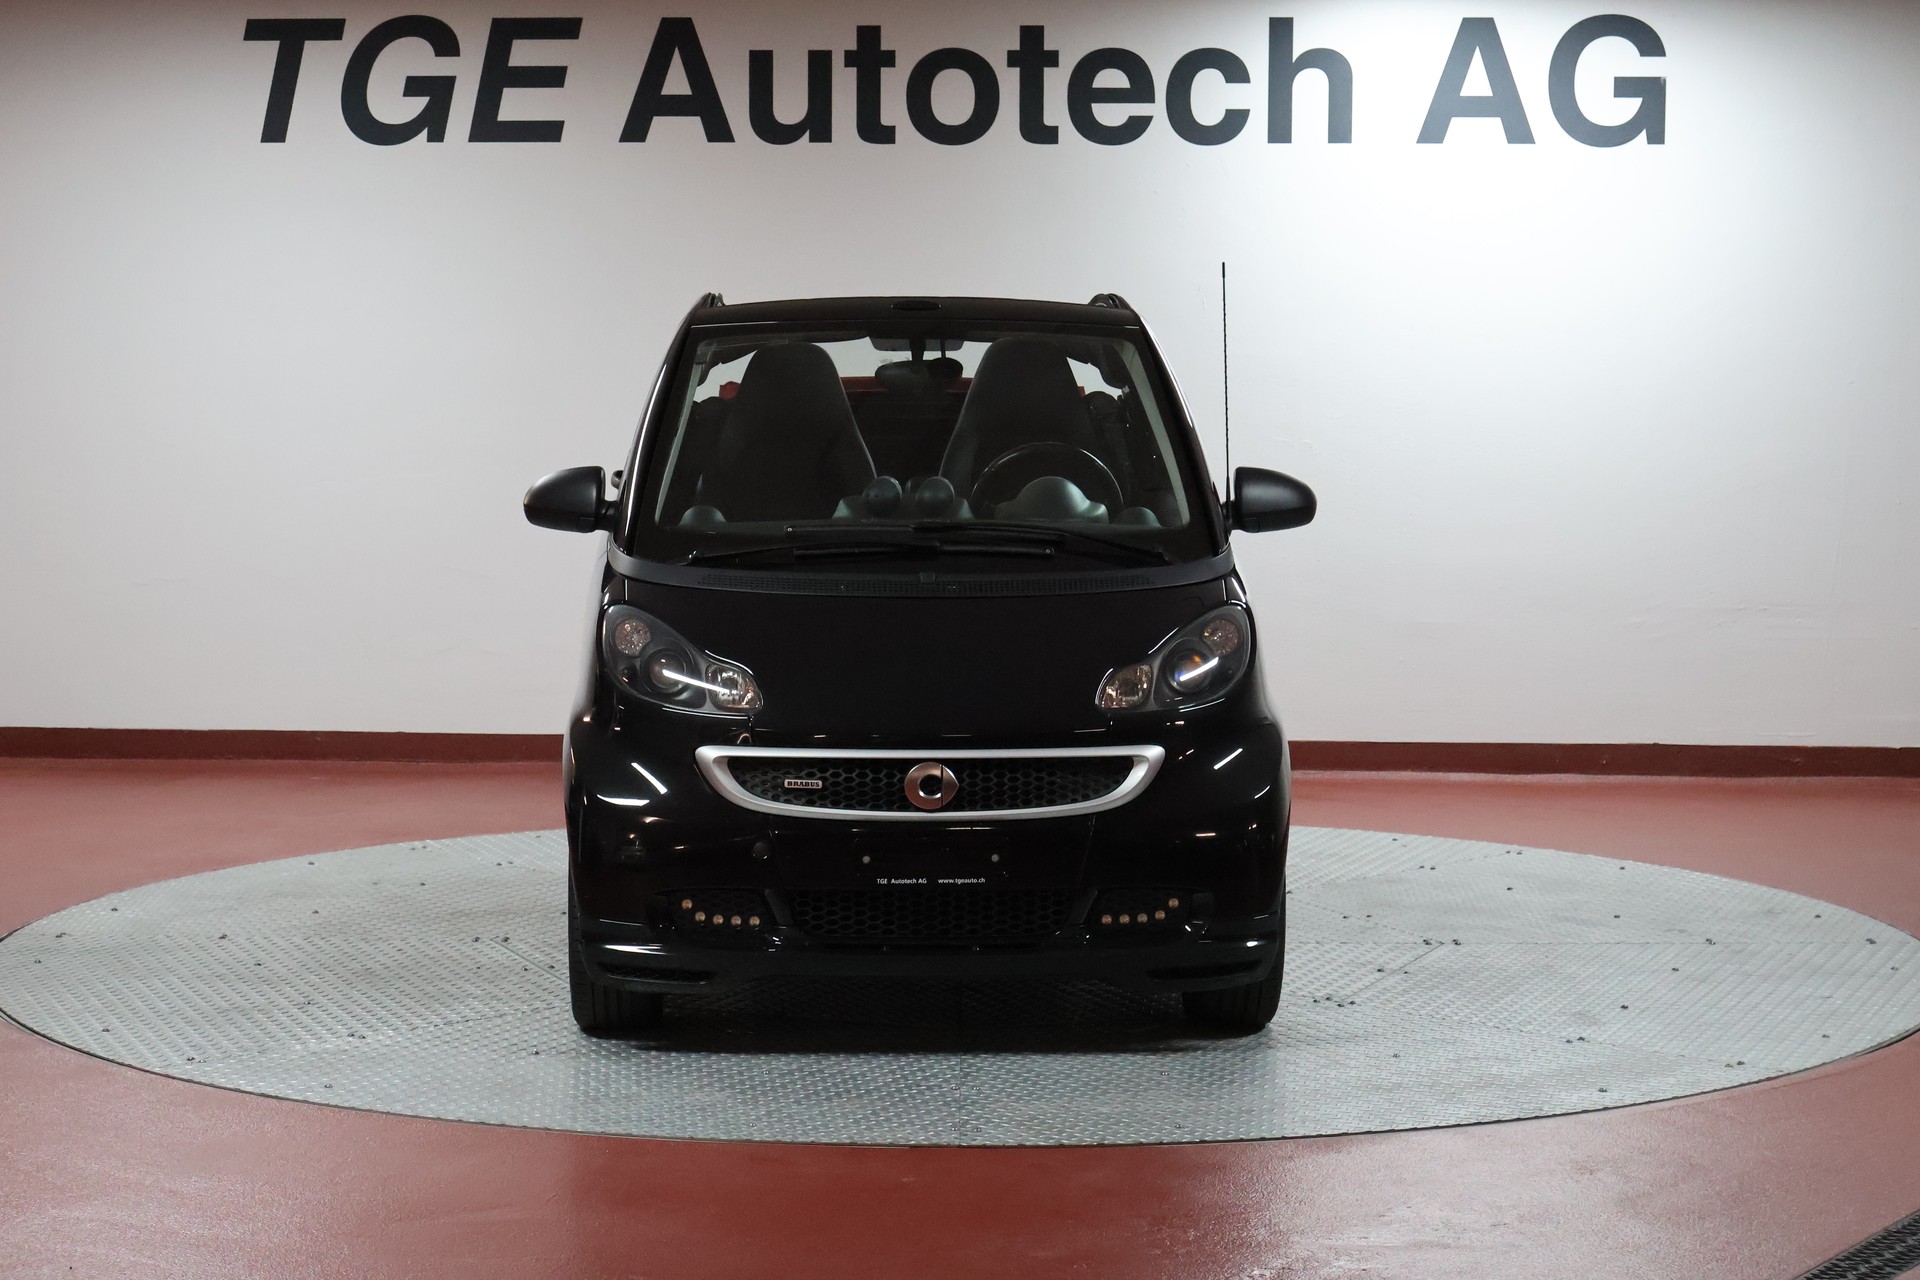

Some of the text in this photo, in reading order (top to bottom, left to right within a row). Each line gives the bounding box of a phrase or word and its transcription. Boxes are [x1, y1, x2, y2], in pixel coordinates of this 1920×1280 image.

[243, 14, 1667, 147] TGE Autotech AG
[938, 877, 986, 885] www.tgeauto.ch
